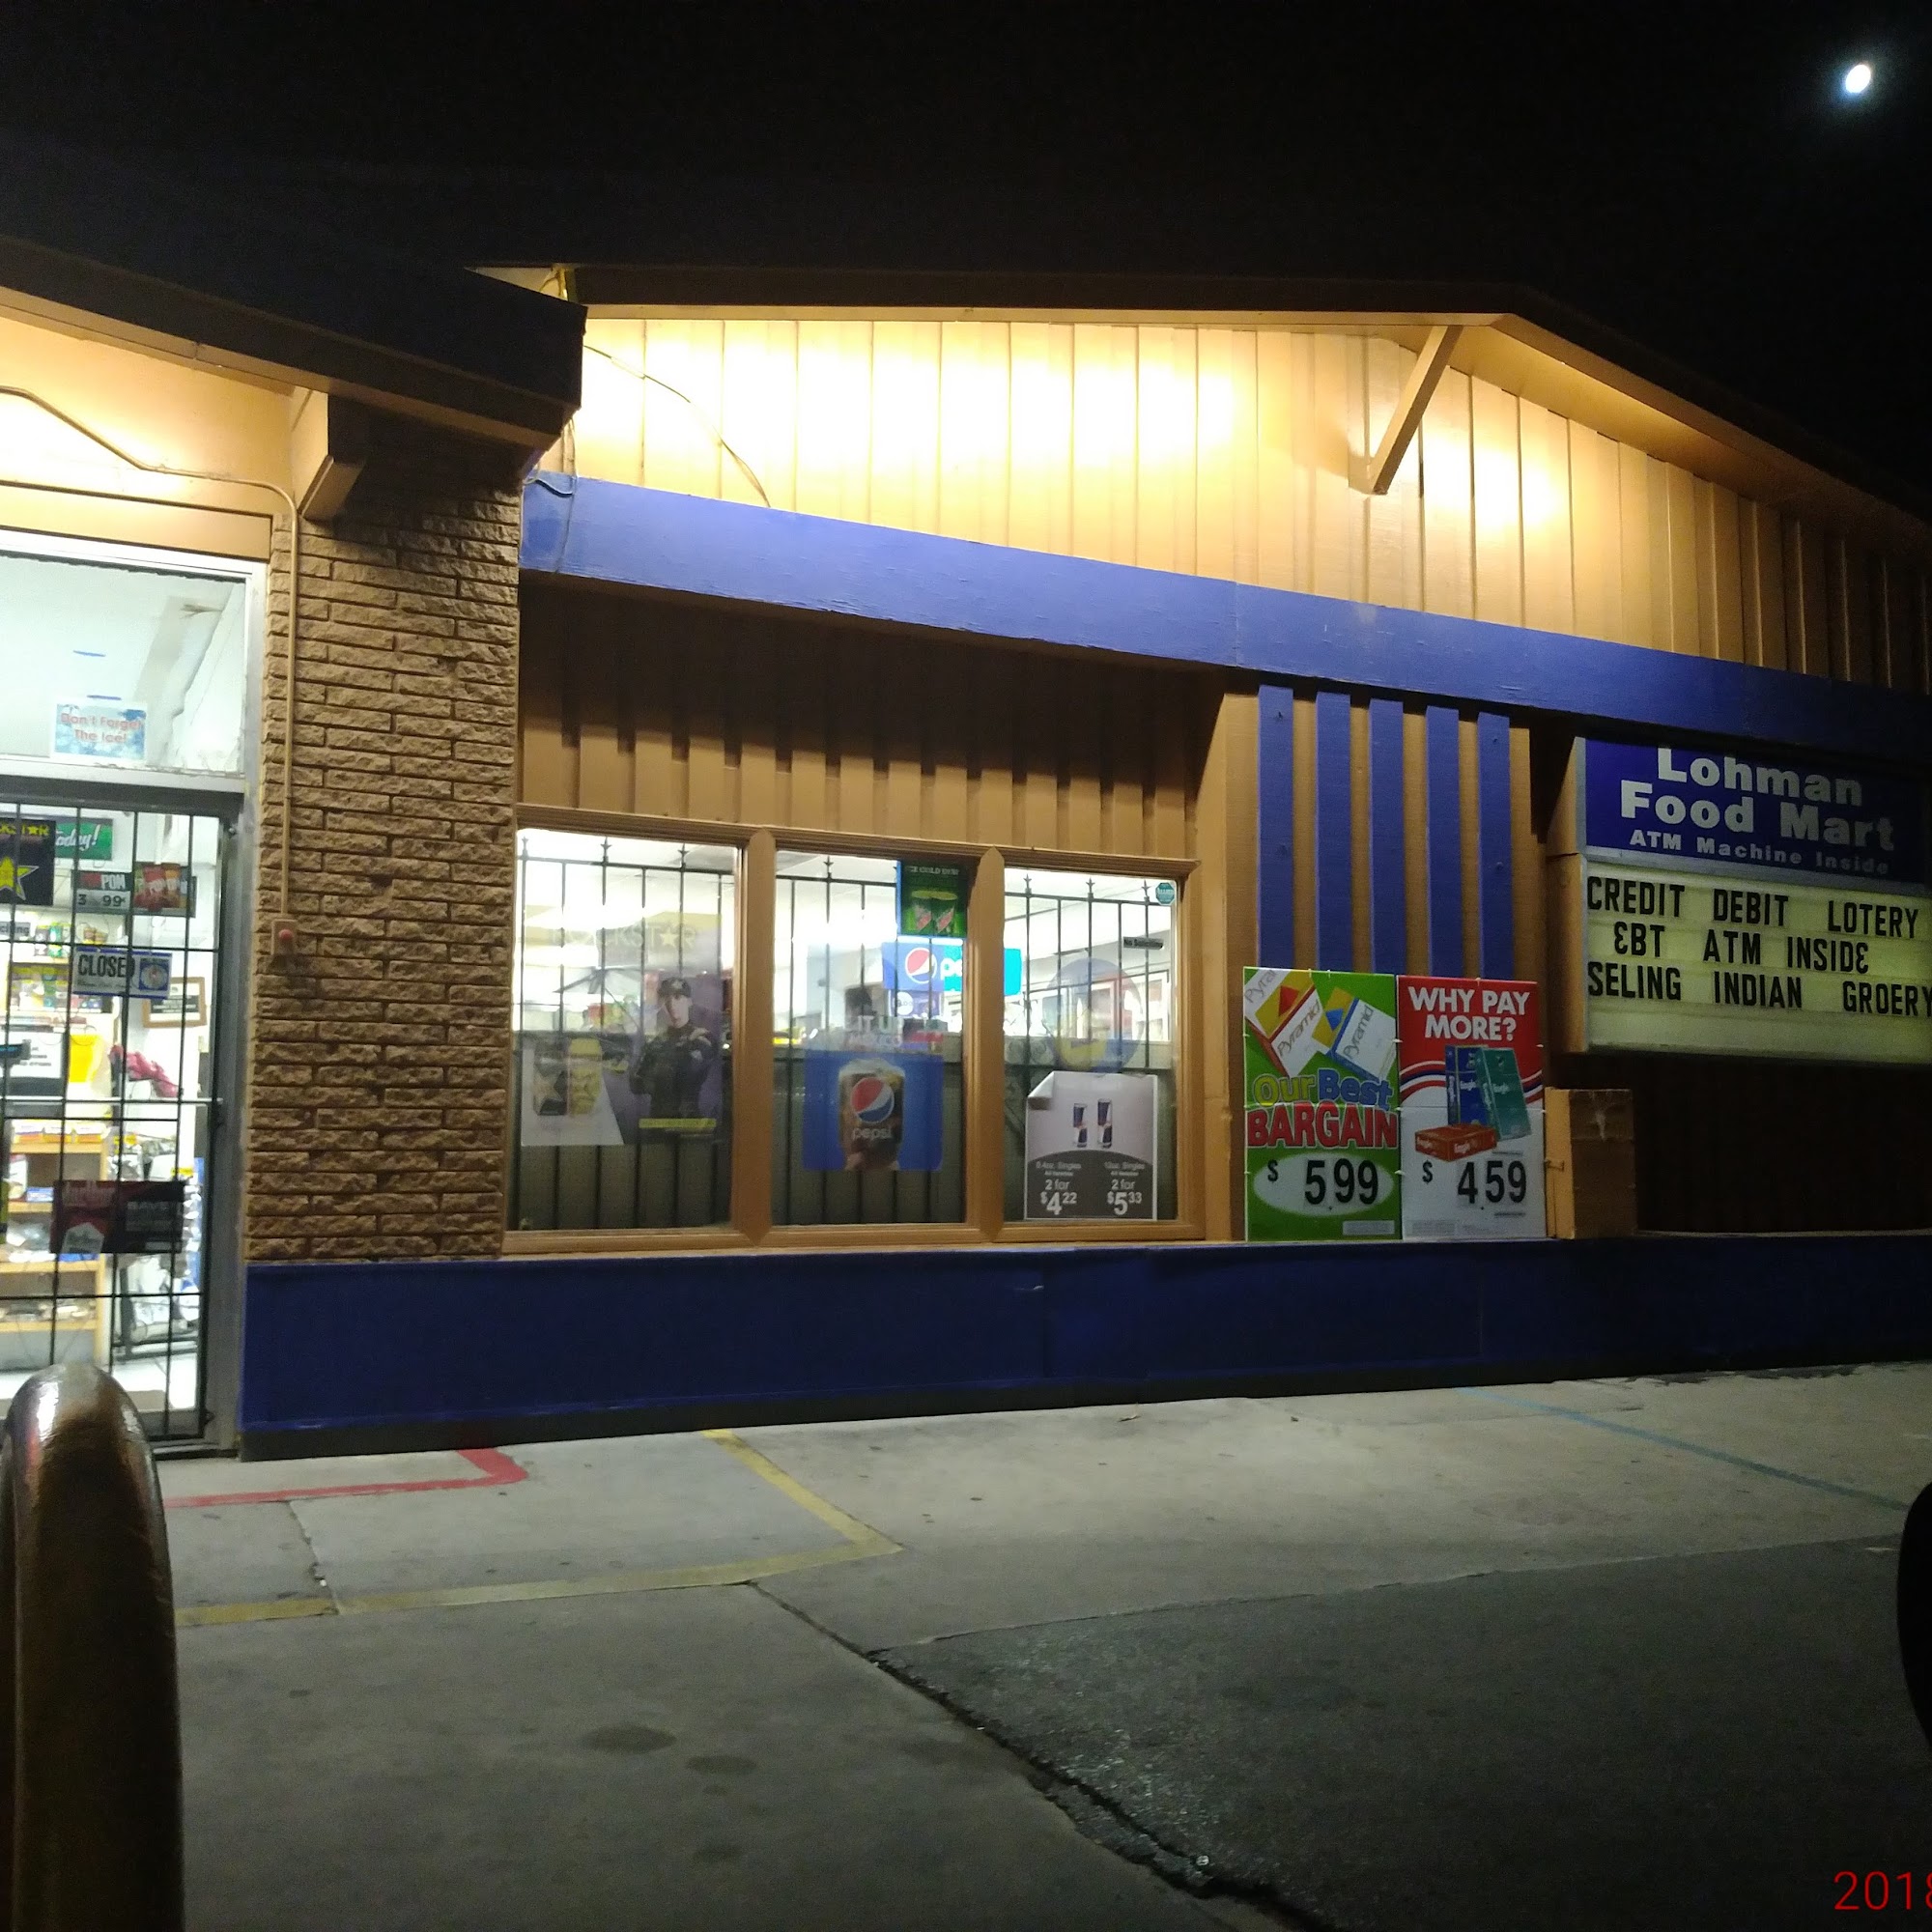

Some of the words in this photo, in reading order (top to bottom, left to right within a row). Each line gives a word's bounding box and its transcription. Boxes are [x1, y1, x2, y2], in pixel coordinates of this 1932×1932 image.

[74, 729, 98, 741] The
[1658, 747, 1862, 807] Lohman
[55, 825, 101, 851] oday!
[1621, 780, 1754, 833] Food
[1780, 802, 1894, 851] Mart
[1630, 829, 1682, 850] ATM
[1696, 836, 1803, 865] Machine
[1816, 851, 1889, 874] Inside
[1587, 876, 1686, 918] CREDIT
[1714, 889, 1788, 926] DEBIT
[1828, 900, 1918, 939] LOTERY
[1614, 922, 1665, 958] EBT
[1703, 929, 1761, 965] ATM
[1787, 937, 1869, 974] INSIDE
[1408, 985, 1474, 1012] WHY
[1482, 989, 1530, 1015] PAY
[1587, 961, 1681, 1001] SELING
[1714, 971, 1803, 1009] INDIAN
[1842, 980, 1932, 1018] GROERY
[1277, 999, 1321, 1057] Pyramid
[1343, 1004, 1375, 1059] Pyramid
[1425, 1015, 1517, 1041] MORE?
[1254, 1073, 1317, 1107] Our
[1316, 1068, 1393, 1111] Best
[1247, 1101, 1399, 1150] BARGAIN
[1045, 1179, 1053, 1190] 2
[1055, 1179, 1070, 1190] for
[1111, 1179, 1119, 1190] 2
[1121, 1179, 1136, 1190] for
[1304, 1158, 1379, 1206] 599
[1457, 1160, 1526, 1205] 459
